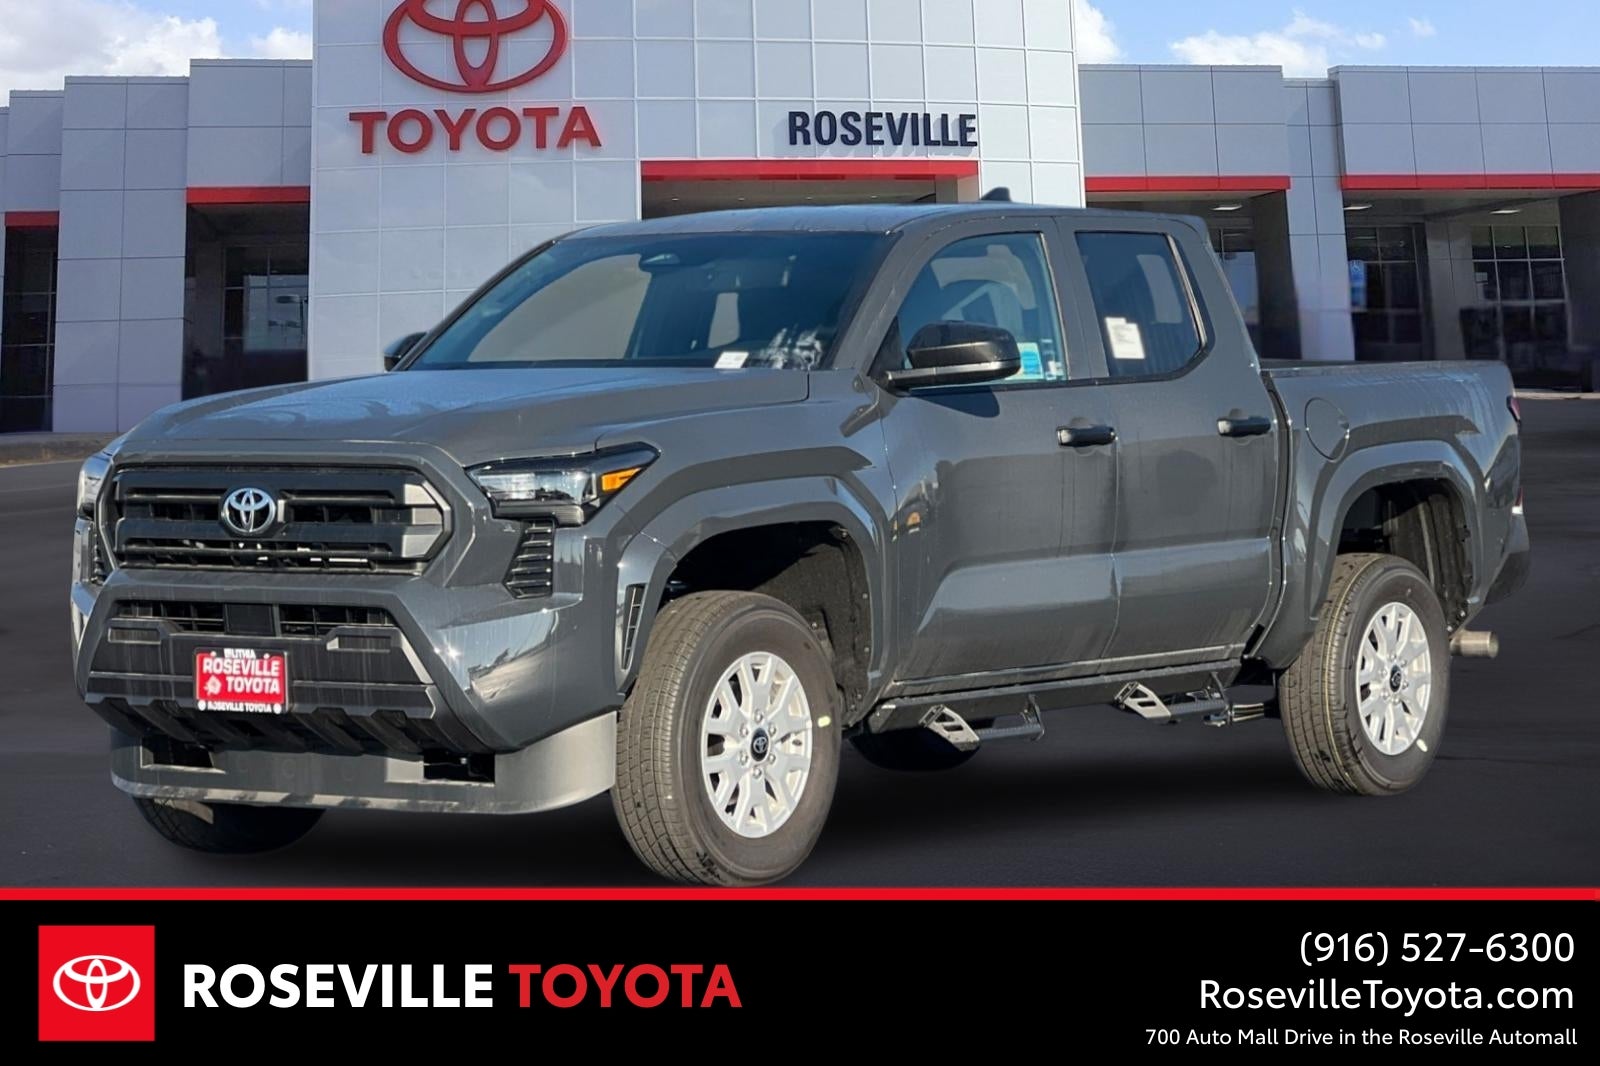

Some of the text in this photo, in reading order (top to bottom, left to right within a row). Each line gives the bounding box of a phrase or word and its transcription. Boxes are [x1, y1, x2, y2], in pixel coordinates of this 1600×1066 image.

[349, 106, 602, 154] TOYOTA
[788, 110, 978, 147] ROSEVILLE
[202, 657, 280, 676] ROSEVILLE
[226, 676, 280, 694] TOYOTA
[245, 702, 272, 713] TOYOTA
